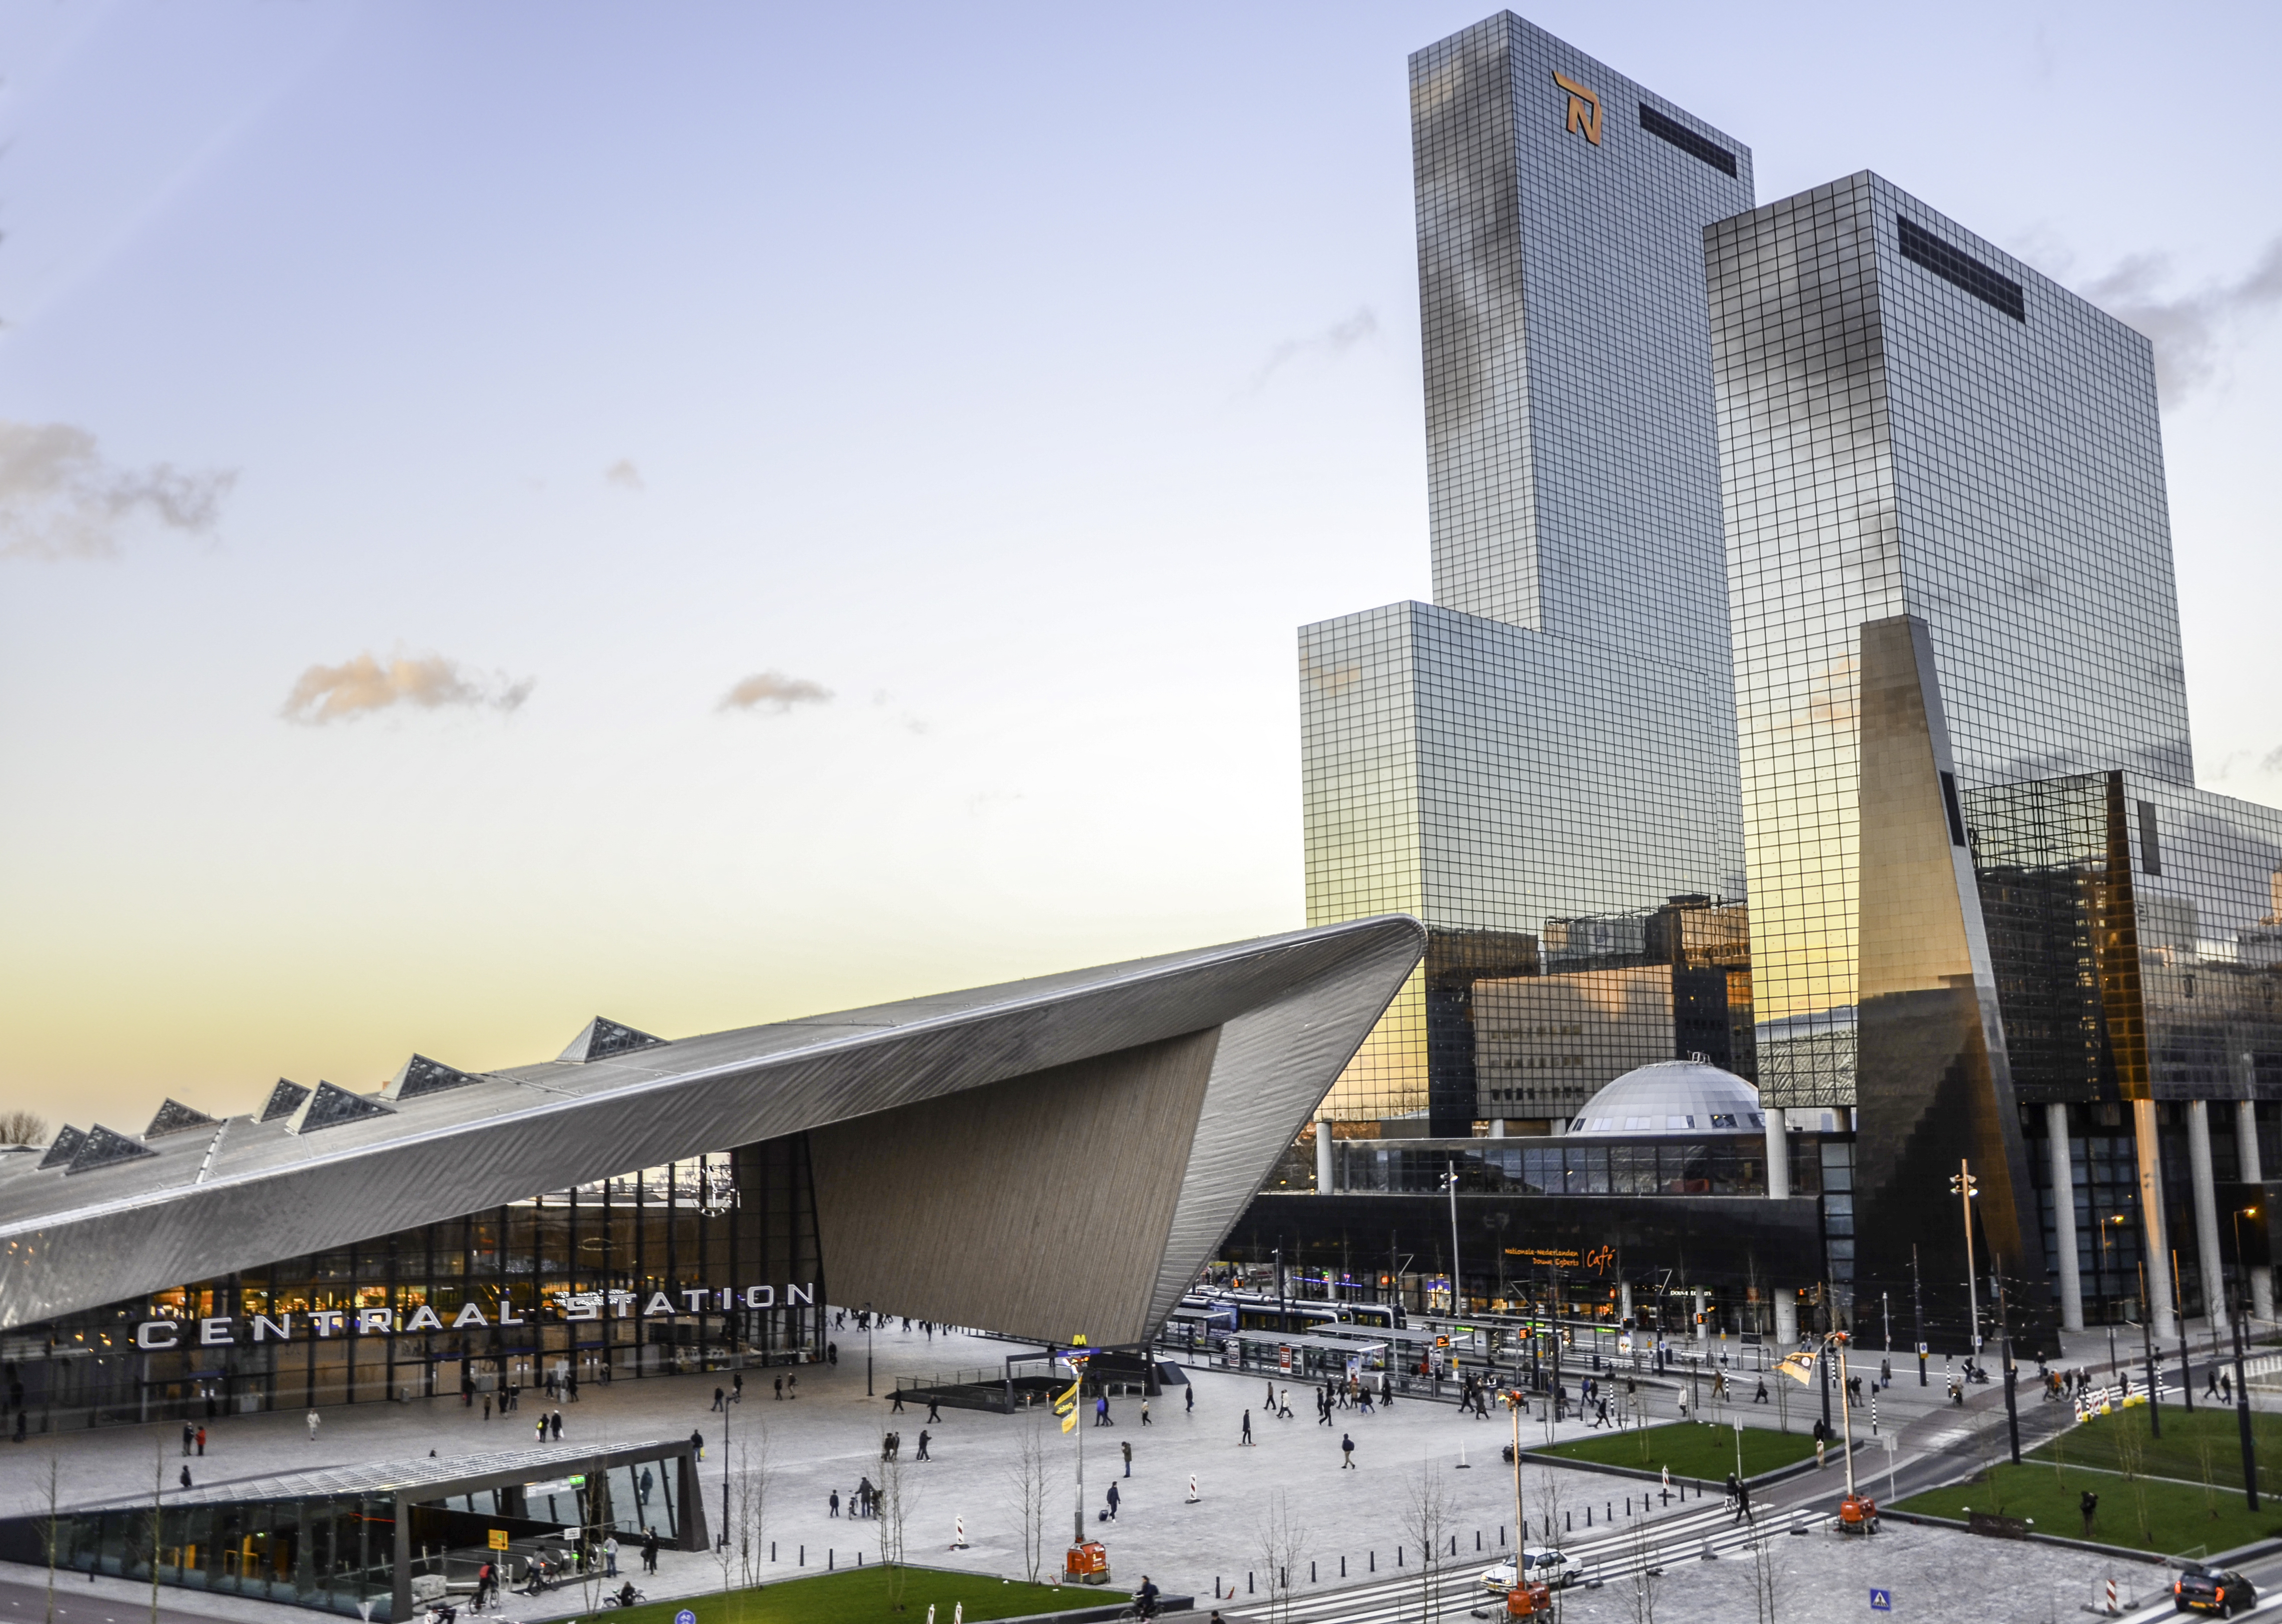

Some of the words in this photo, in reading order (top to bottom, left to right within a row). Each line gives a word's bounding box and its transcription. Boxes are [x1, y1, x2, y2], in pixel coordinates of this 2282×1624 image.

[1505, 1247, 1579, 1257] Nationale-Nederlanden
[1587, 1245, 1615, 1275] Café
[1555, 1258, 1579, 1268] Egberts
[137, 1300, 524, 1349] CENTRAAL
[566, 1283, 814, 1320] STATION
